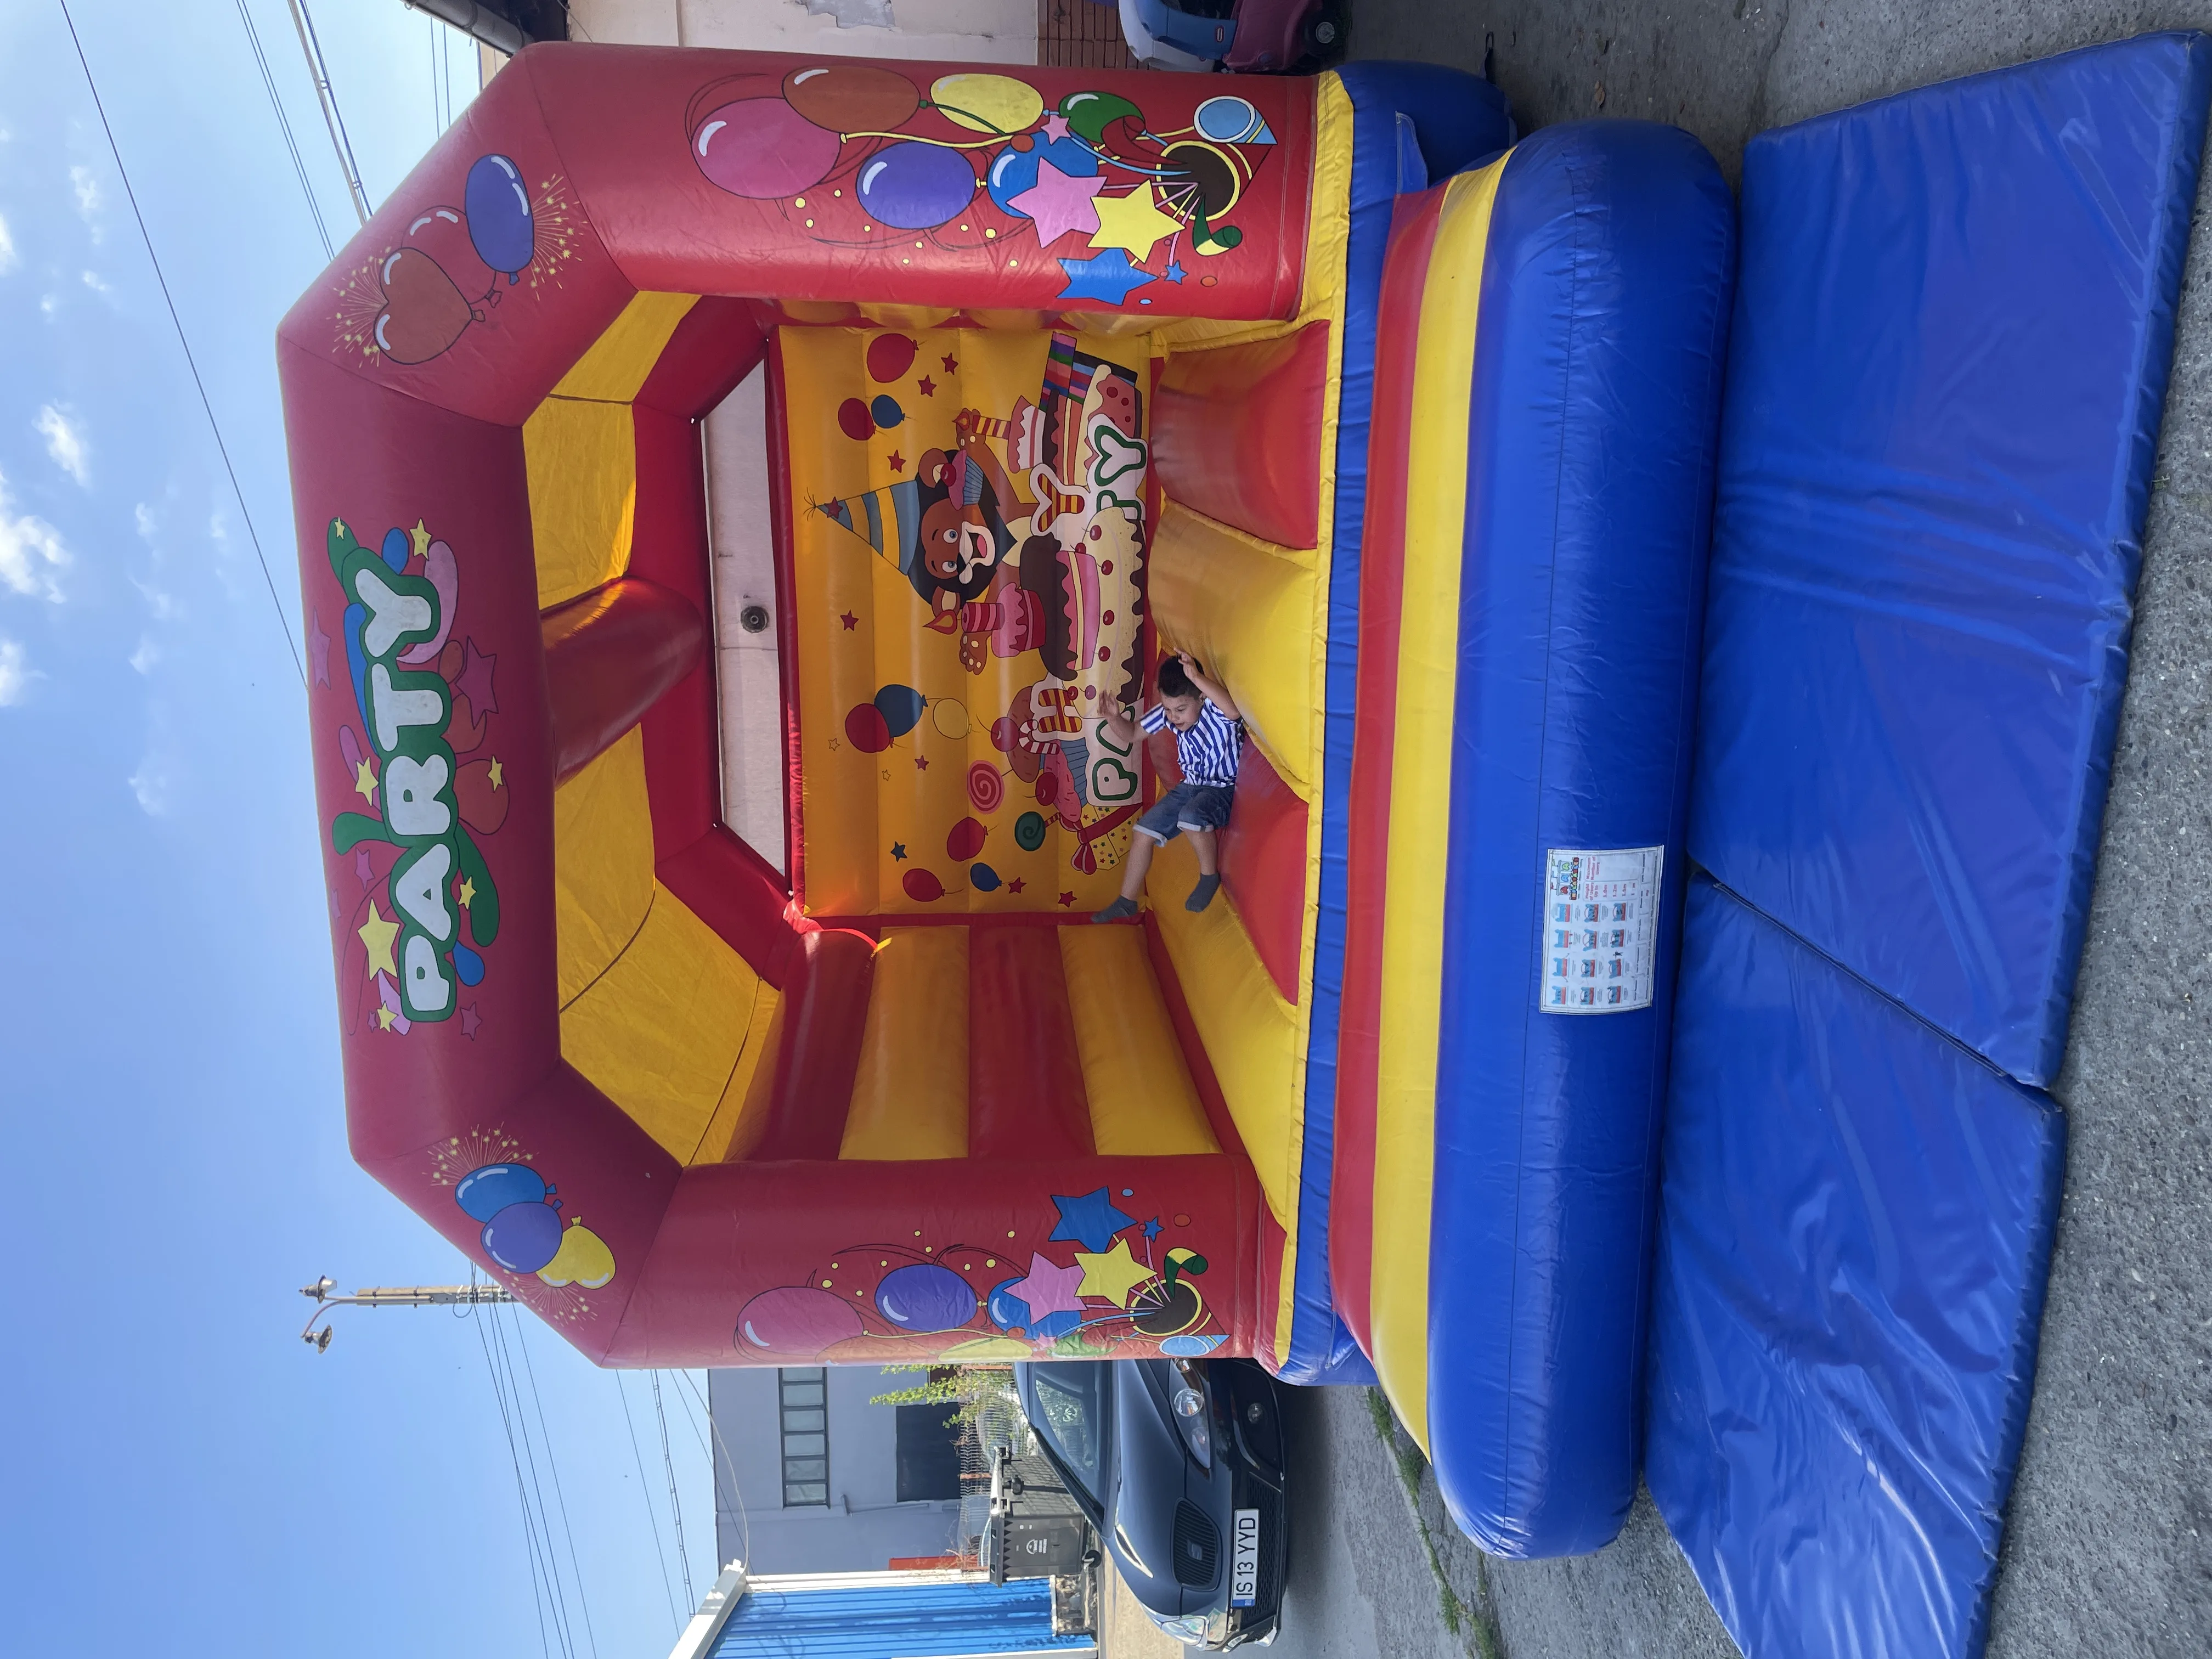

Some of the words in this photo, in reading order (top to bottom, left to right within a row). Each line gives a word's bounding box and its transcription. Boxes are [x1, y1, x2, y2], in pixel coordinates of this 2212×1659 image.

[352, 566, 454, 1013] PARTY
[1238, 1517, 1256, 1555] YYD
[1237, 1561, 1254, 1576] 13
[1235, 1582, 1253, 1595] IS
